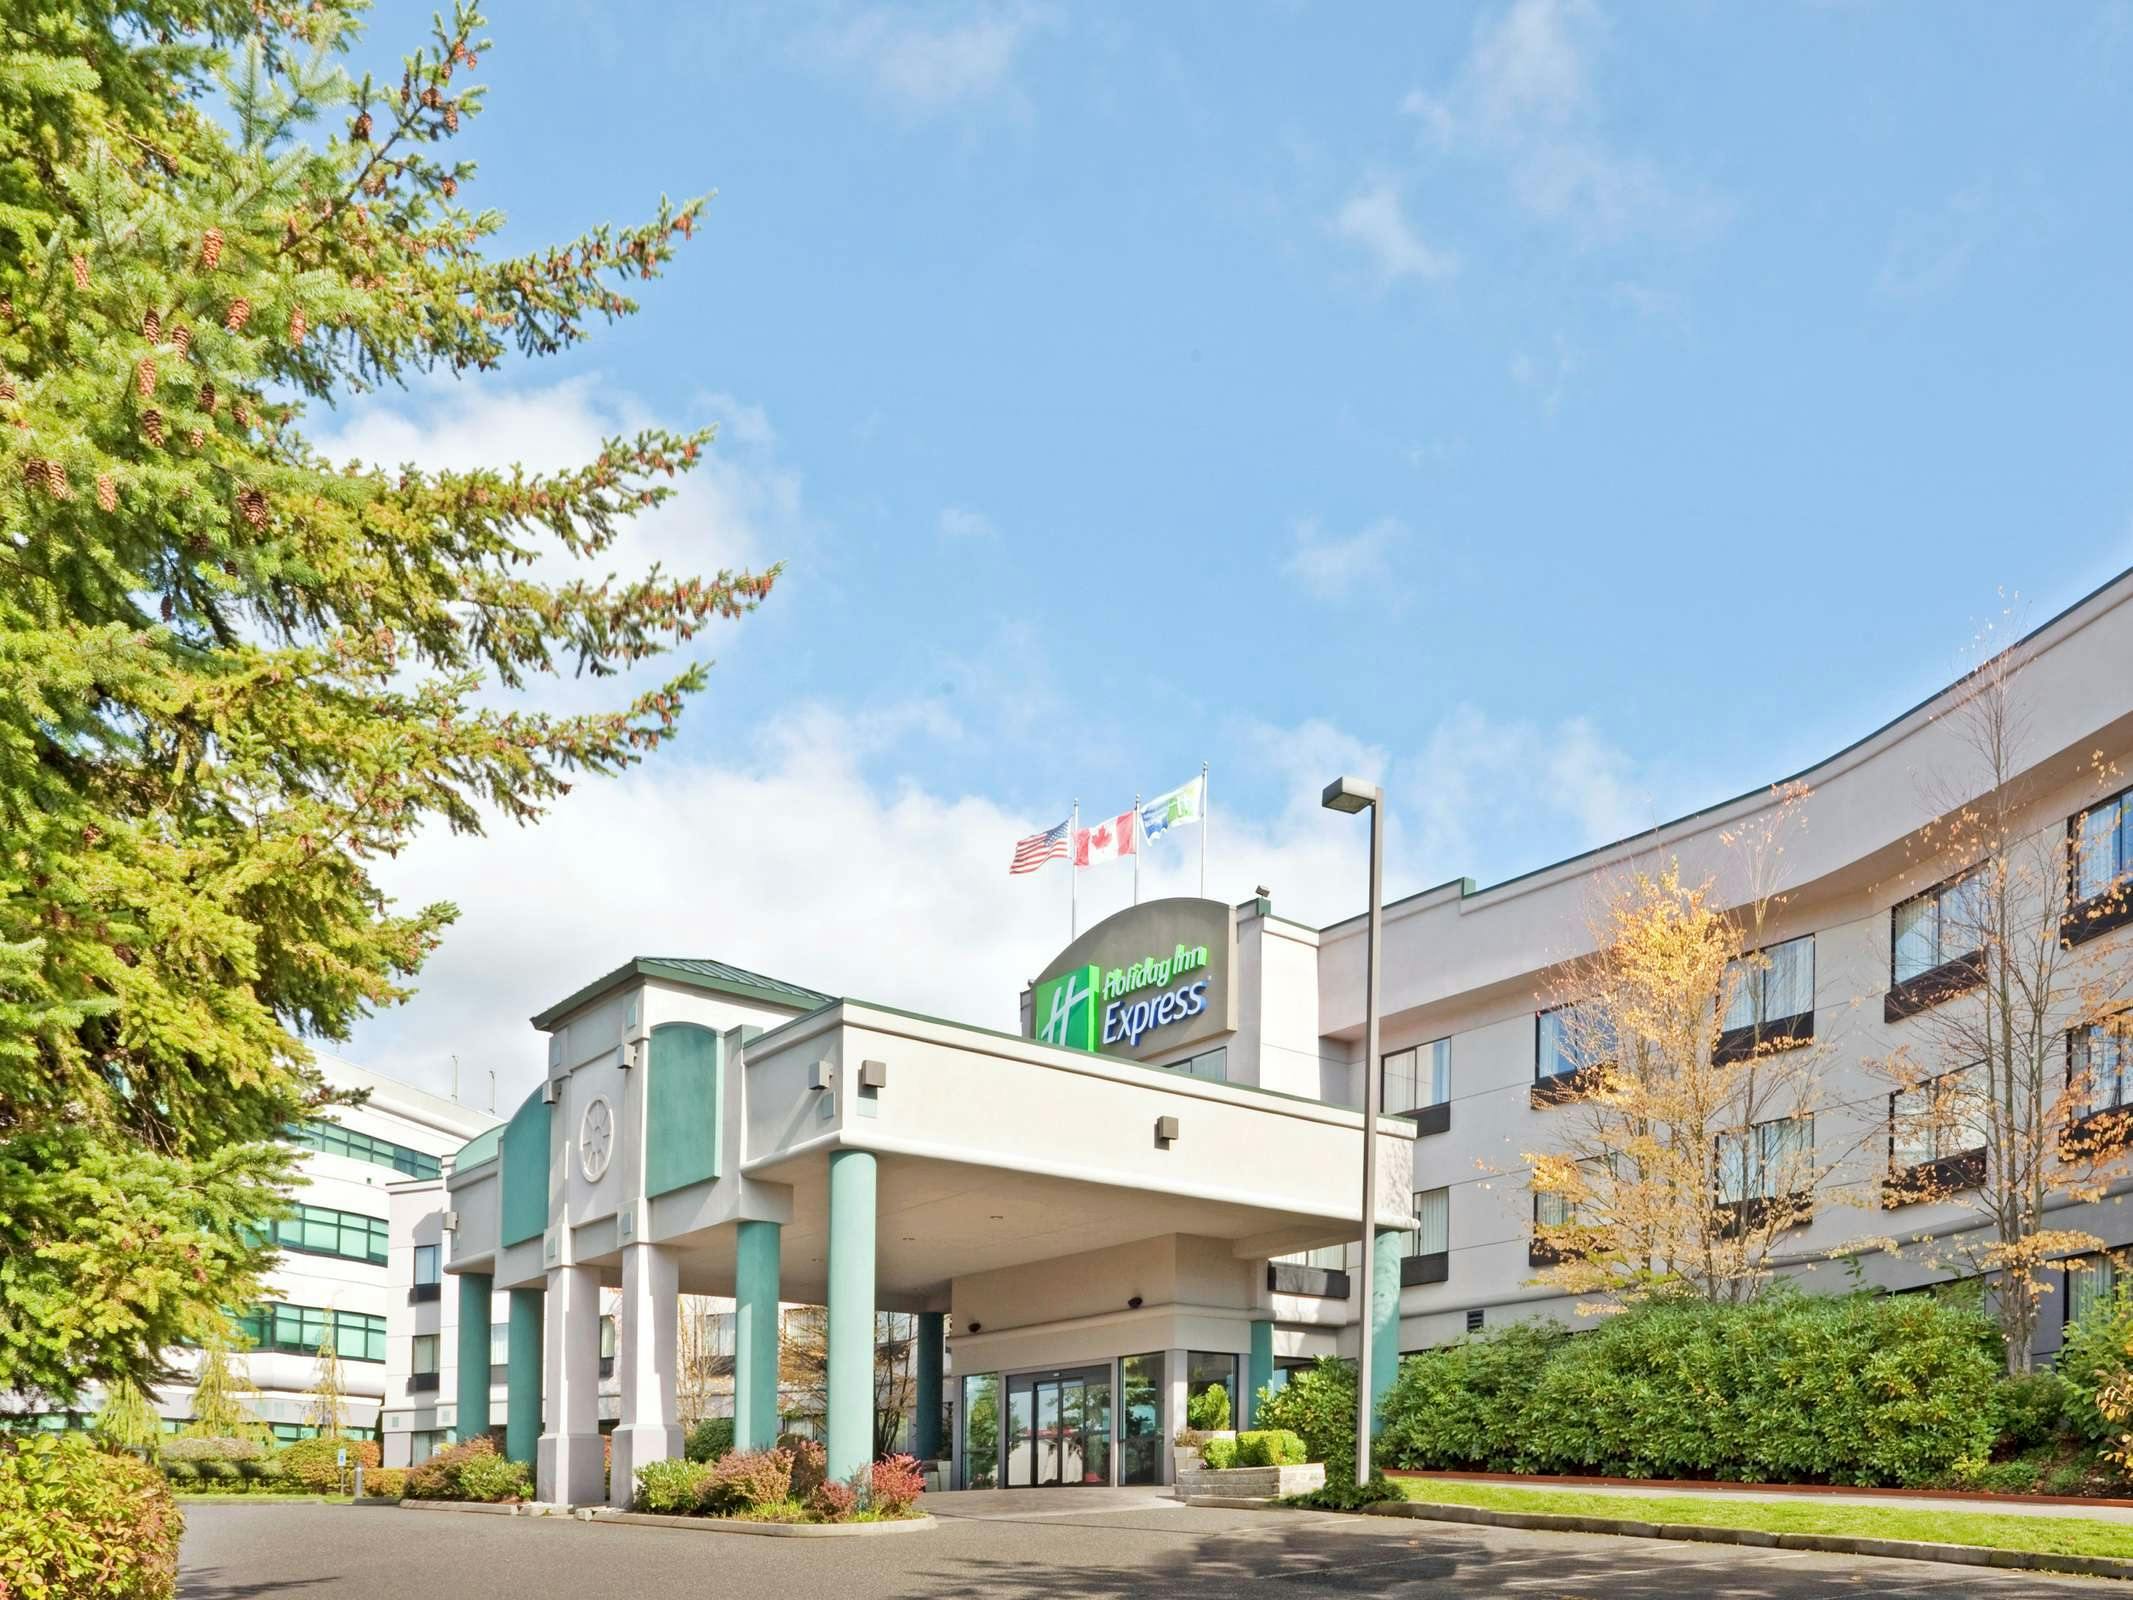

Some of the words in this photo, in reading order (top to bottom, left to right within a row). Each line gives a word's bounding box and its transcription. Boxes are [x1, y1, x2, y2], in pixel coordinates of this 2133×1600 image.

[1103, 957, 1172, 1001] Holiday
[1172, 944, 1208, 975] Inn
[1102, 981, 1207, 1046] Express
